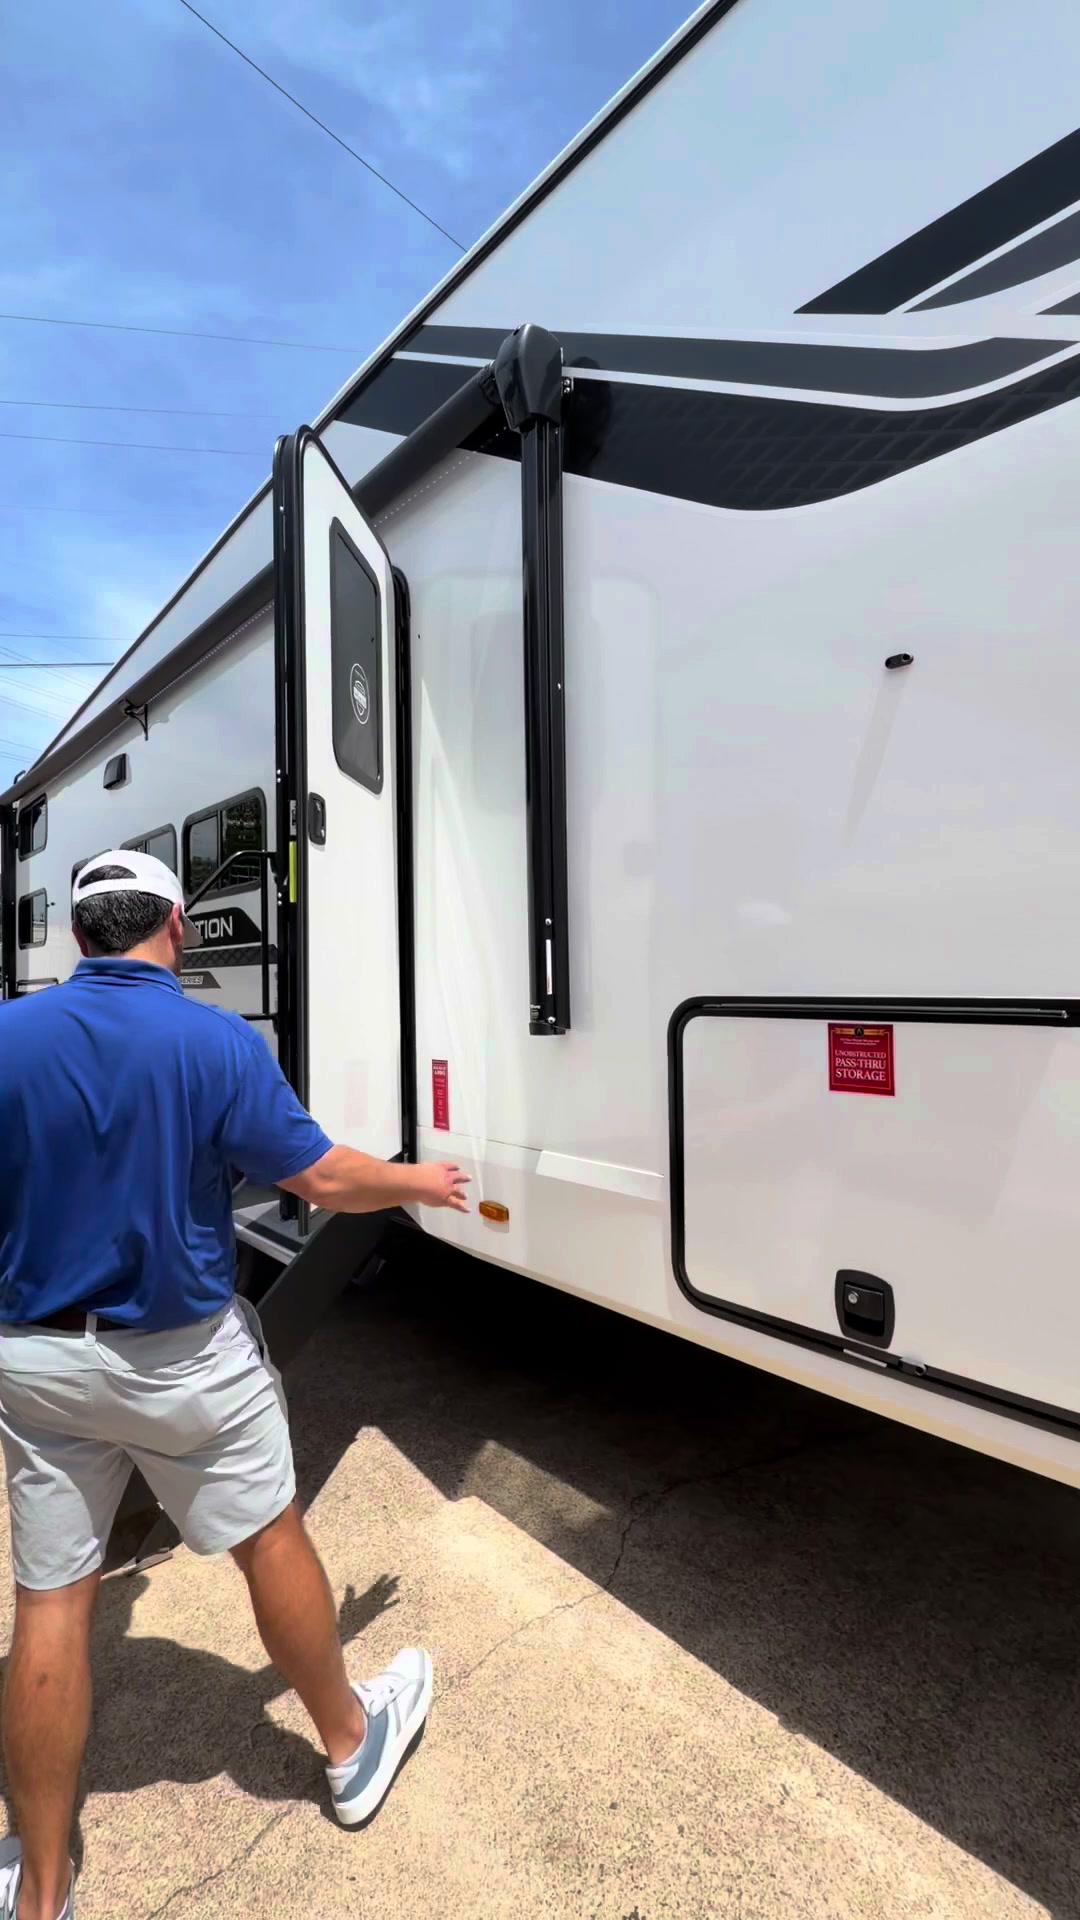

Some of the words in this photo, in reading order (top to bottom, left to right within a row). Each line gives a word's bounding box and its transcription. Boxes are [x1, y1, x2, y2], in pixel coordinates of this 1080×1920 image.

[834, 1049, 887, 1059] UNOBSTRUCTED
[835, 1057, 887, 1070] PASS-THRU
[835, 1068, 887, 1082] STORAGE
